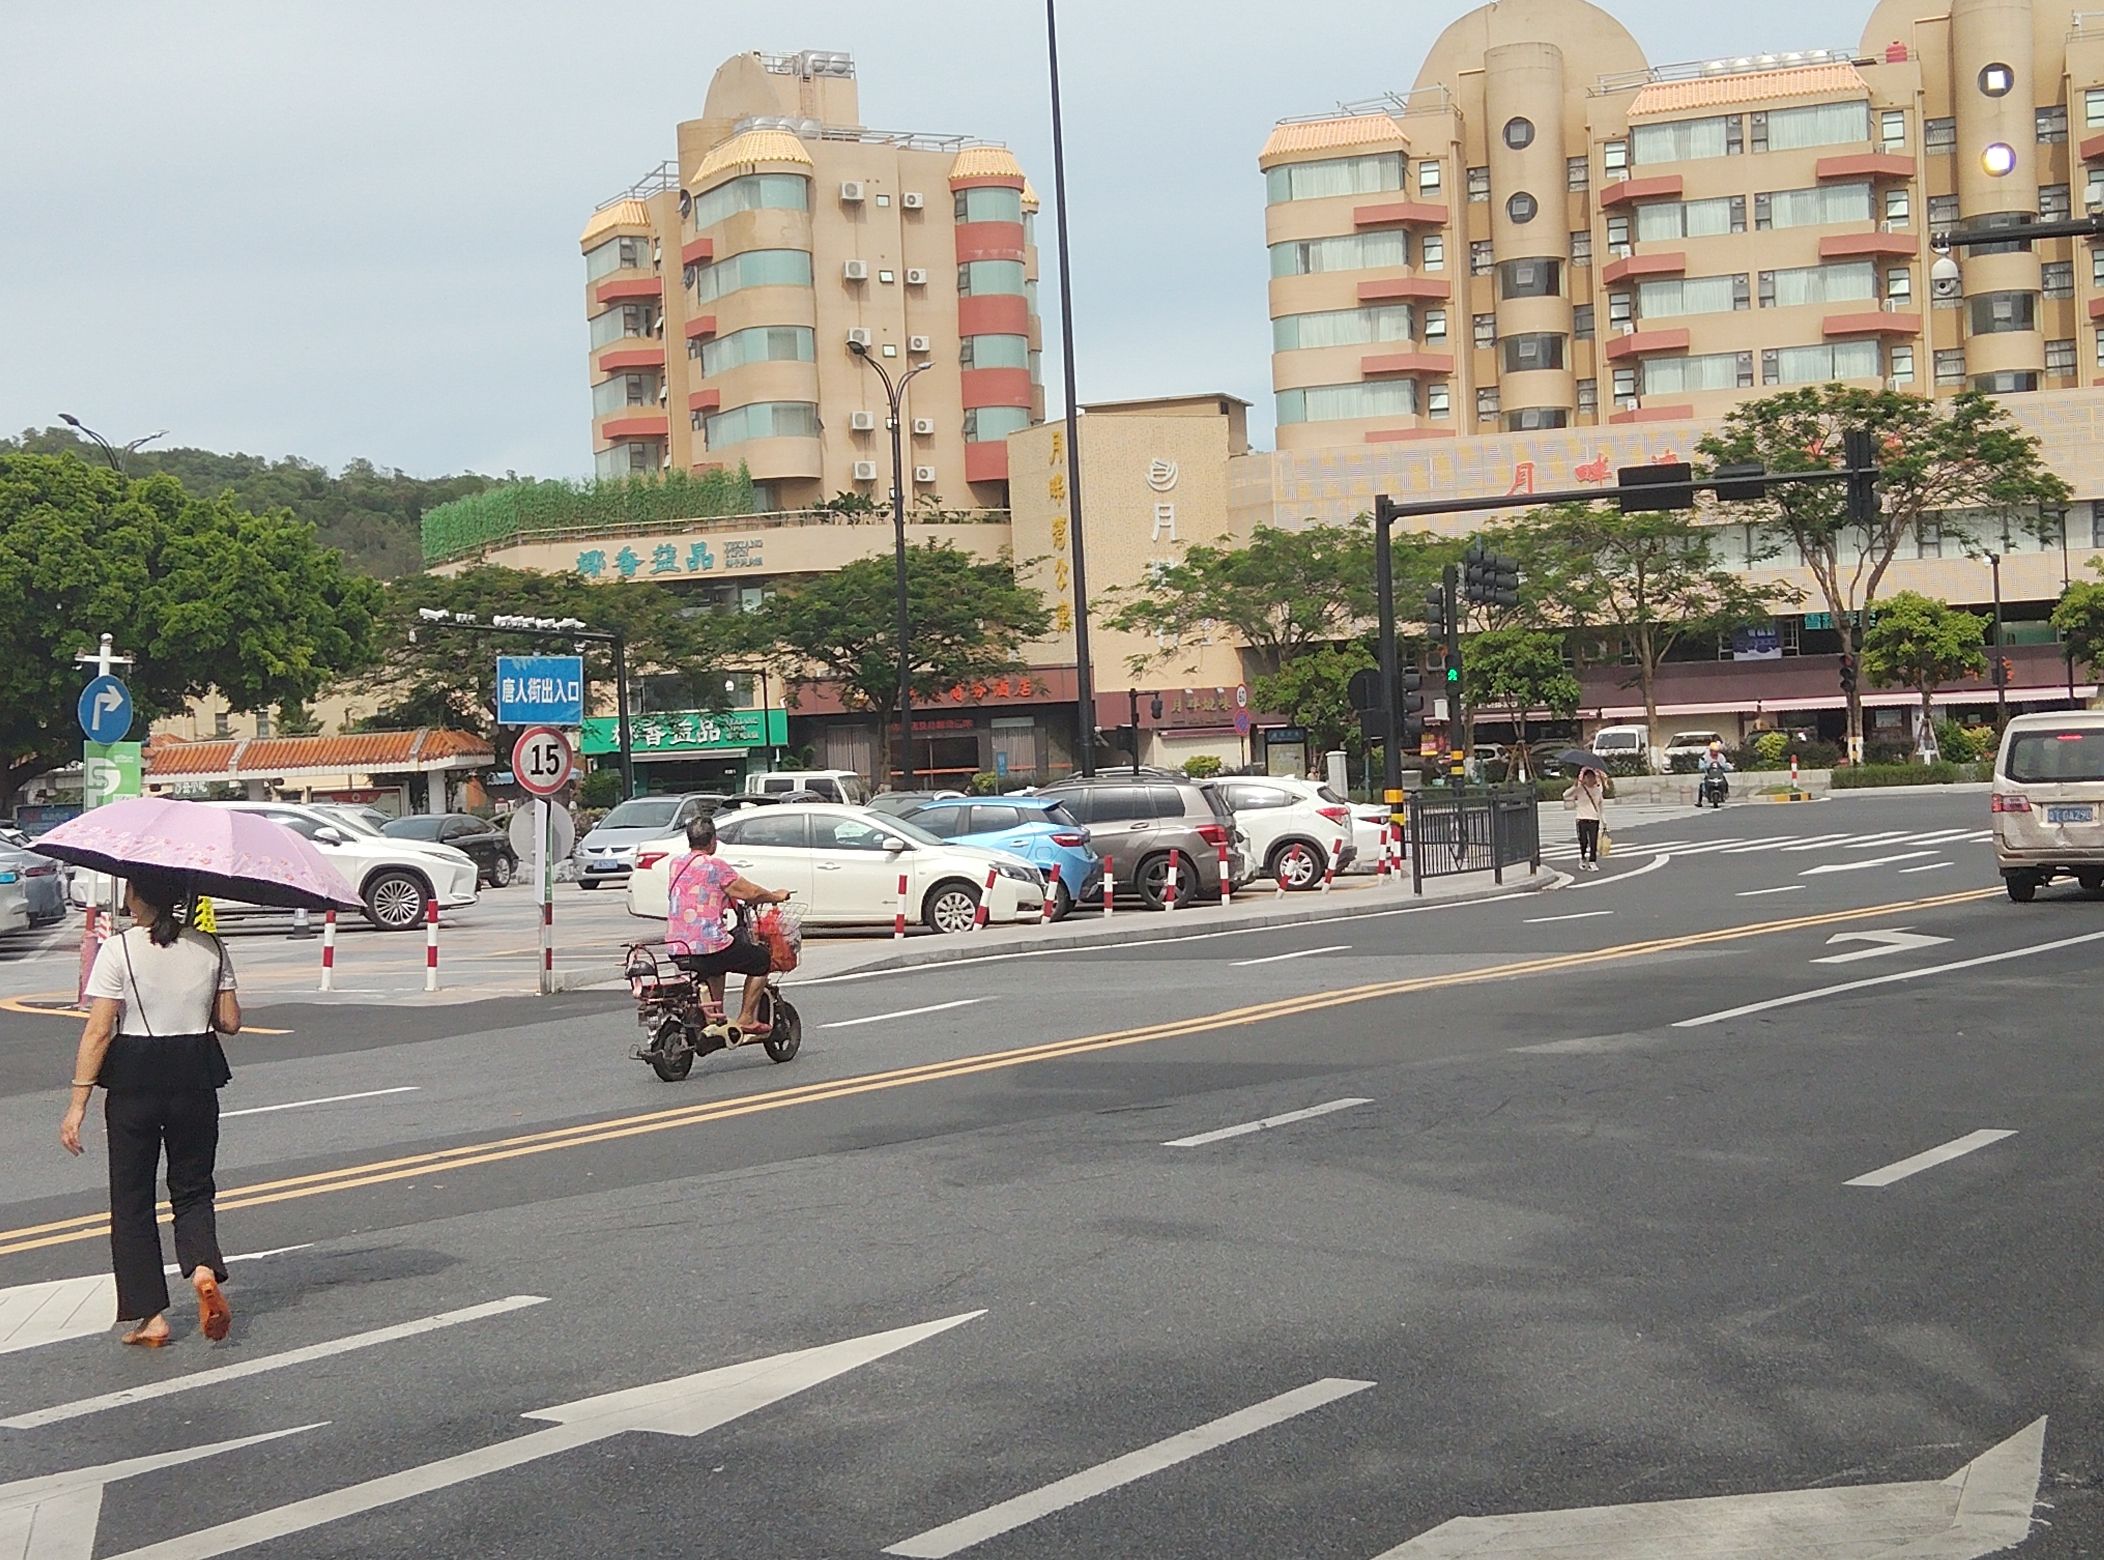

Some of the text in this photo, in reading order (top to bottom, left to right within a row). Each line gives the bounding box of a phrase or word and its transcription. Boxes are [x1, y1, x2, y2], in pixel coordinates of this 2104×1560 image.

[577, 541, 714, 578] 椰香益品
[502, 678, 579, 704] 唐人街出入口
[530, 744, 560, 776] 15
